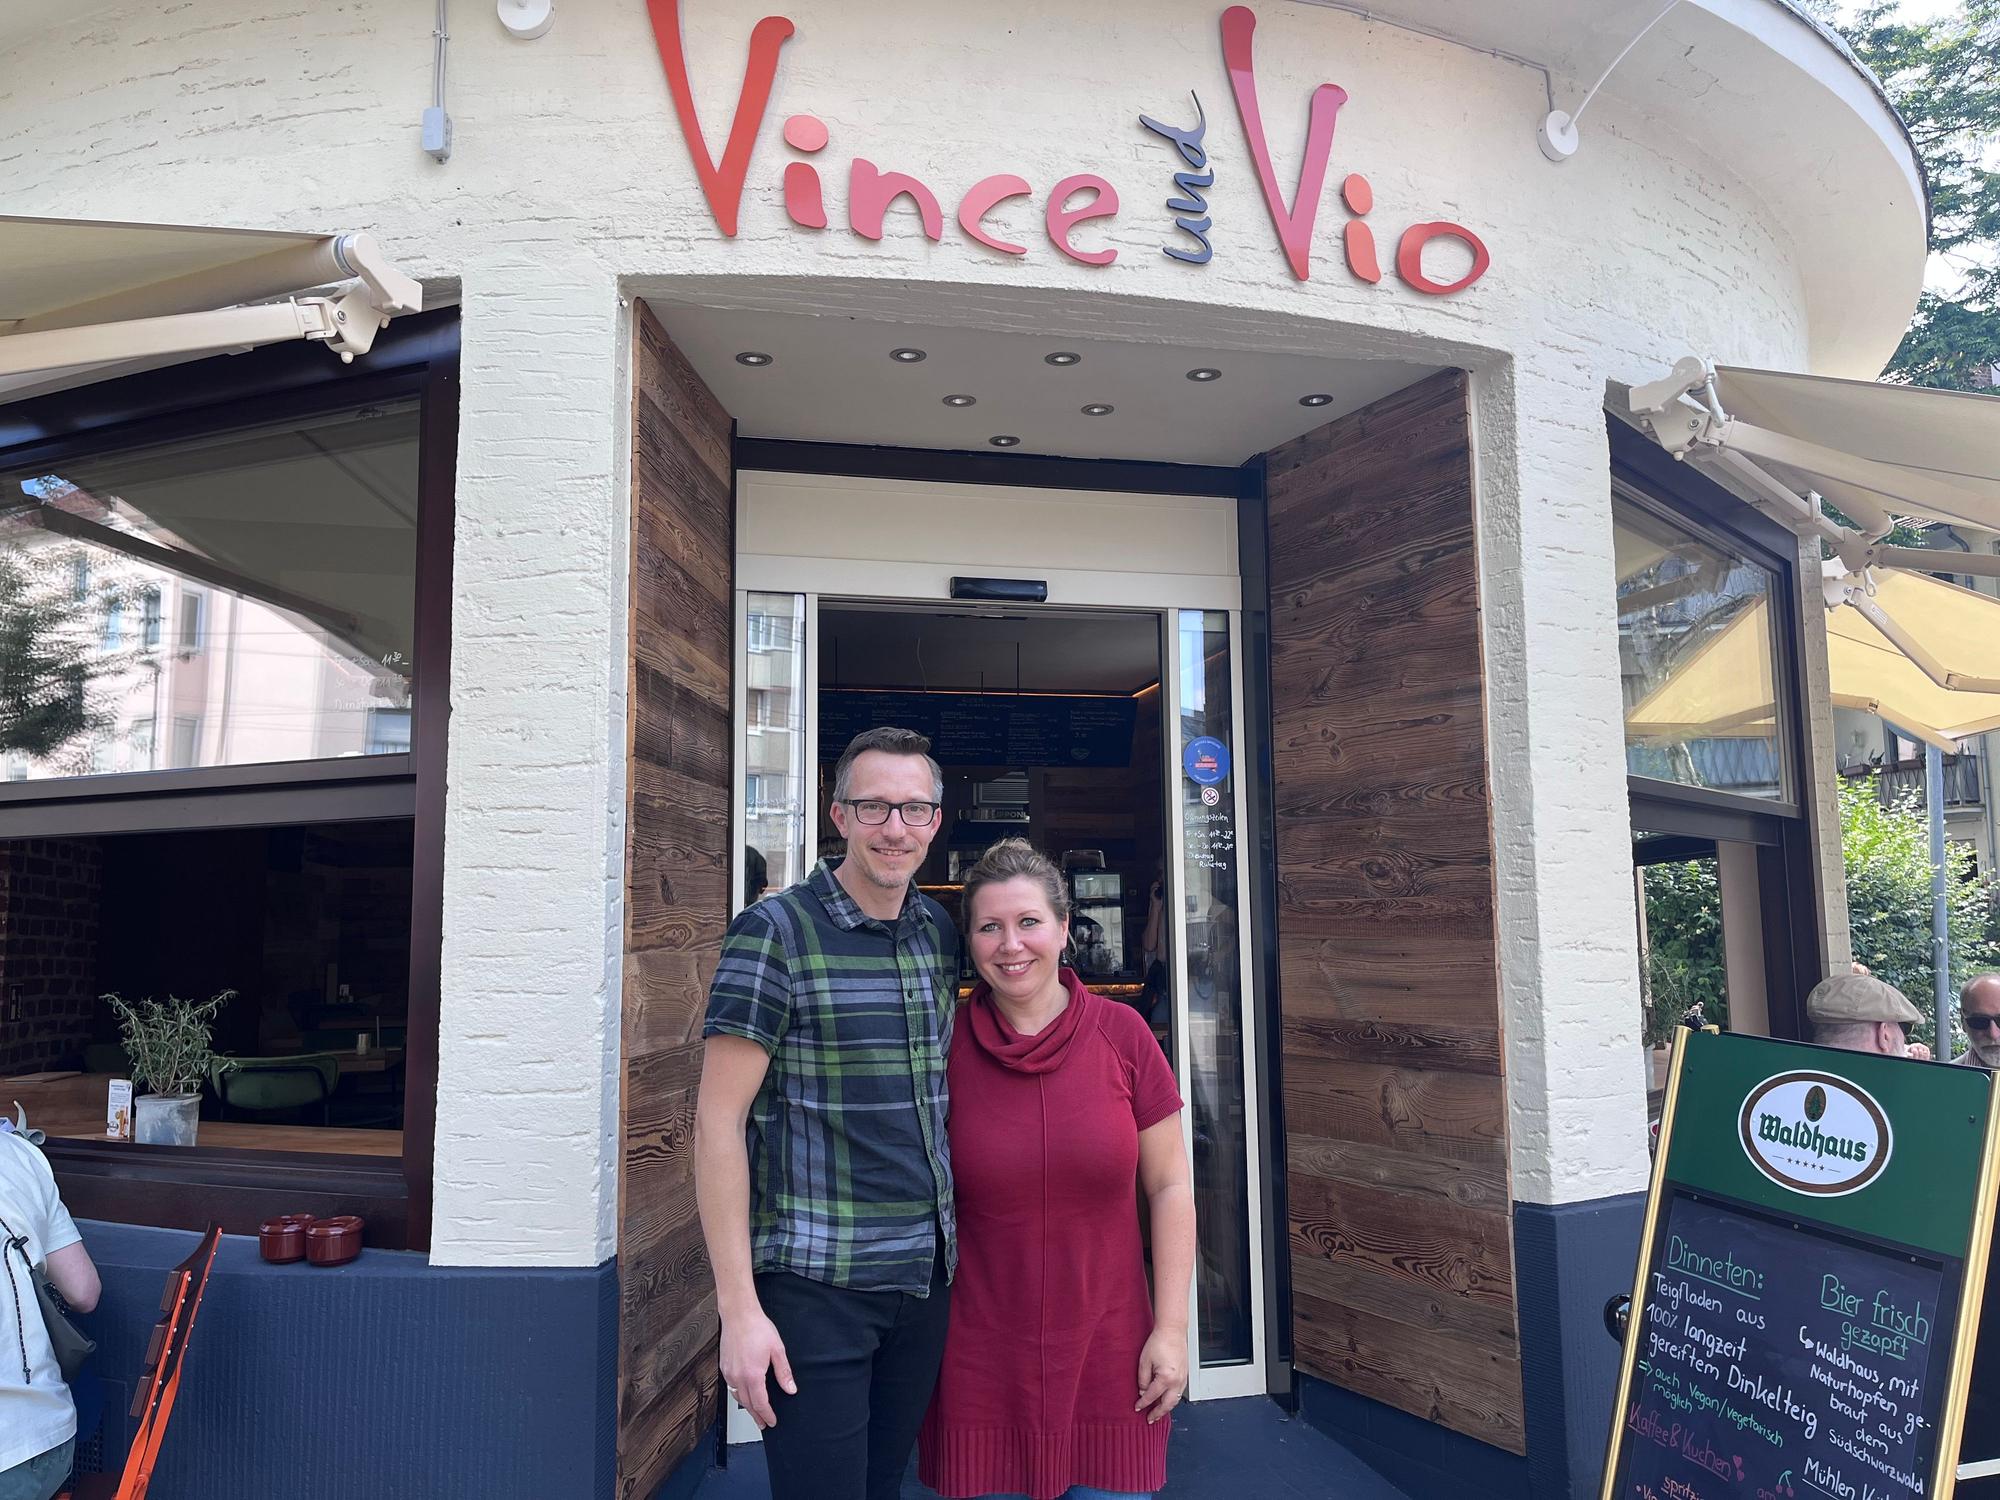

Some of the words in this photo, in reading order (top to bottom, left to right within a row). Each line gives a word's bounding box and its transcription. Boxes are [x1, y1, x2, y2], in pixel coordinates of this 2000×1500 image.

[646, 0, 1119, 267] Vince
[1221, 6, 1490, 295] Vio
[1139, 89, 1214, 265] und
[1758, 1113, 1868, 1163] Waldhaus
[1668, 1235, 1763, 1289] Dinneten:
[1653, 1272, 1722, 1314] Teigfladen
[1736, 1308, 1766, 1330] aus
[1821, 1273, 1864, 1315] Bier
[1872, 1290, 1929, 1342] frisch
[1646, 1303, 1679, 1329] 100%
[1684, 1315, 1747, 1361] langzeit
[1840, 1321, 1909, 1357] gezapft
[1649, 1332, 1720, 1380] gereiftem
[1727, 1364, 1818, 1440] Dinkelteig
[1652, 1383, 1693, 1414] möglich
[1655, 1368, 1681, 1388] auch
[1810, 1363, 1898, 1417] Naturhopfen
[1904, 1412, 1932, 1435] ge-
[1816, 1341, 1884, 1390] Waldhaus,
[1888, 1376, 1919, 1399] mit
[1628, 1400, 1669, 1443] Kaffee
[1682, 1428, 1732, 1479] Kuchen
[1829, 1393, 1868, 1424] braut
[1878, 1422, 1903, 1445] aus
[1855, 1427, 1889, 1455] dem
[1803, 1456, 1856, 1500] Mühlen
[1828, 1428, 1924, 1496] Südschwarzwald
